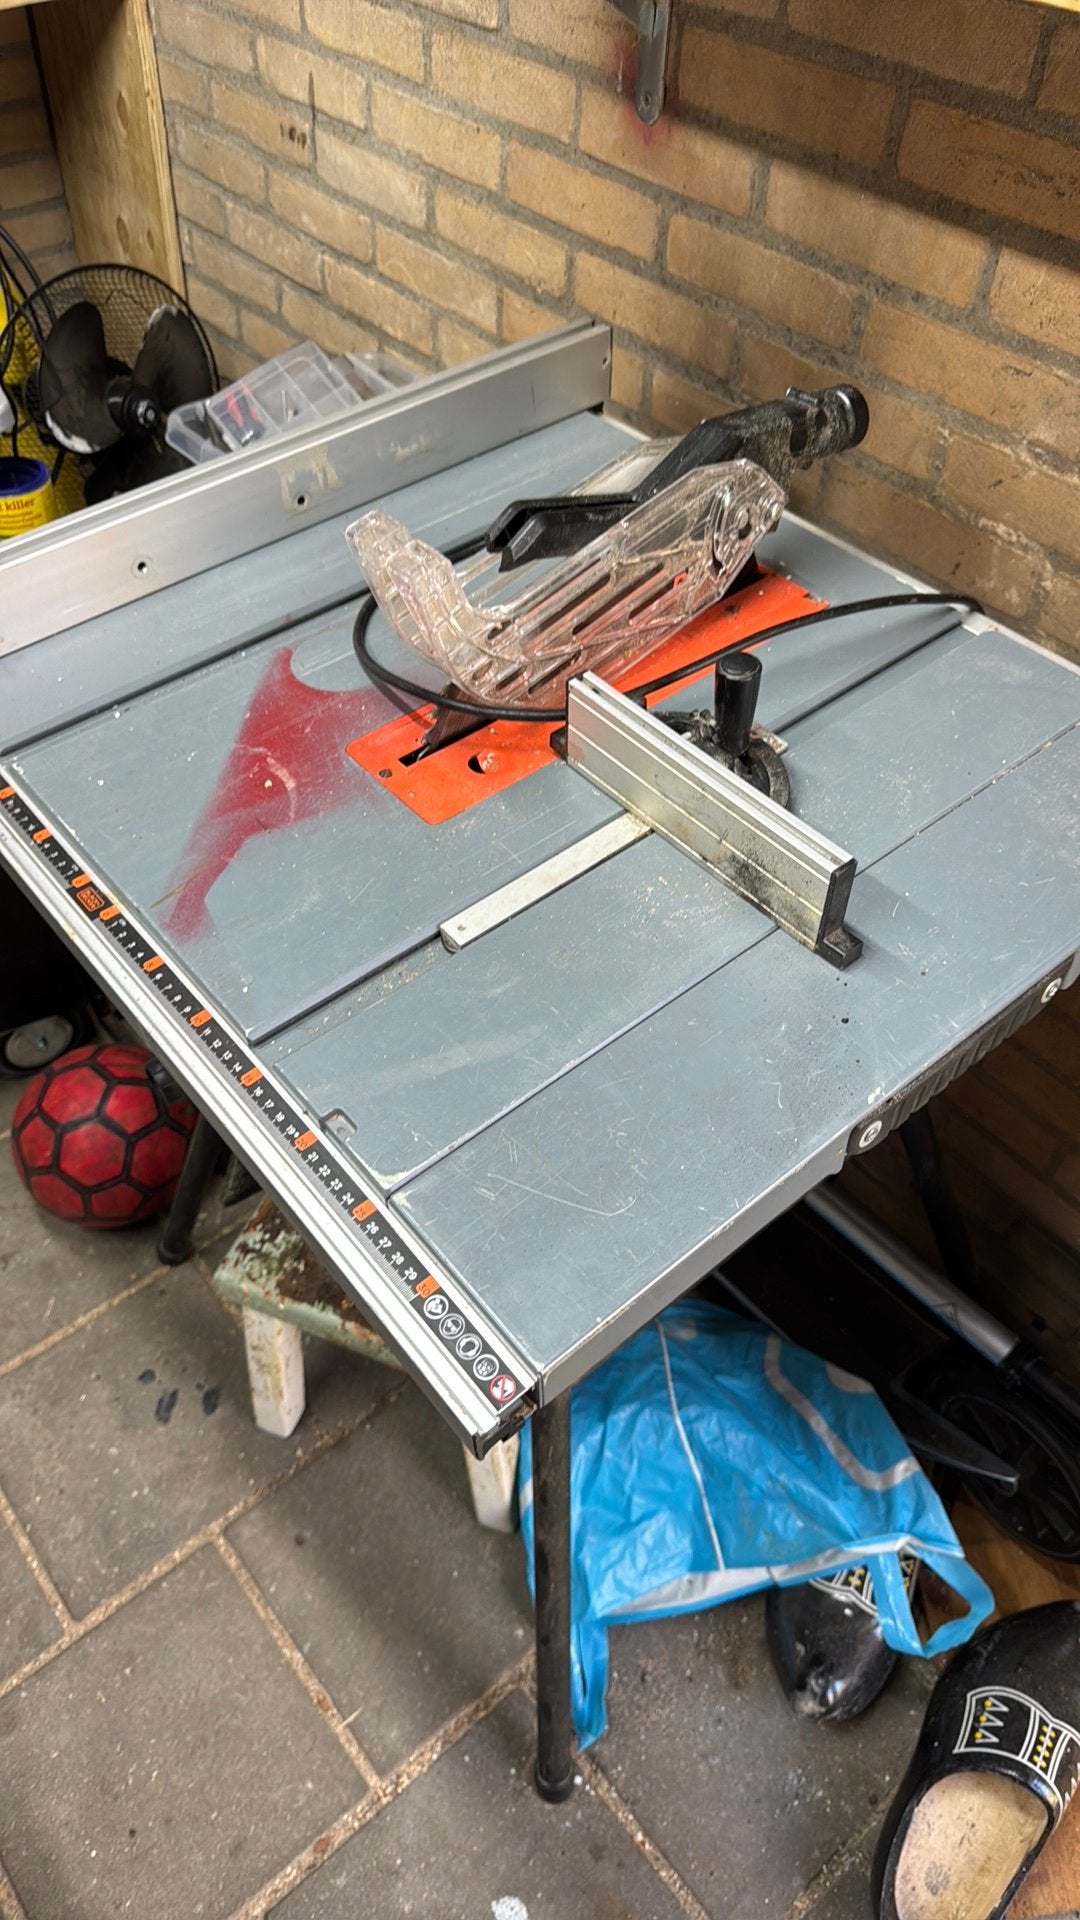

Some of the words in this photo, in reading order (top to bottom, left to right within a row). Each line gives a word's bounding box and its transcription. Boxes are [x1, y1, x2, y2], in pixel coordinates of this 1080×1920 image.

[4, 499, 34, 511] killer
[212, 1038, 222, 1048] 12
[222, 1050, 233, 1060] 13
[232, 1061, 243, 1072] 14
[253, 1086, 264, 1097] 16
[264, 1098, 275, 1108] 17
[275, 1111, 285, 1122] 18
[285, 1123, 296, 1135] 19
[308, 1151, 319, 1162] 21
[319, 1164, 331, 1177] 22
[330, 1178, 343, 1191] 23
[342, 1192, 355, 1205] 24
[366, 1221, 379, 1235] 26
[379, 1236, 392, 1248] 27
[391, 1251, 405, 1264] 28
[404, 1266, 417, 1280] 29
[418, 1283, 431, 1295] 30
